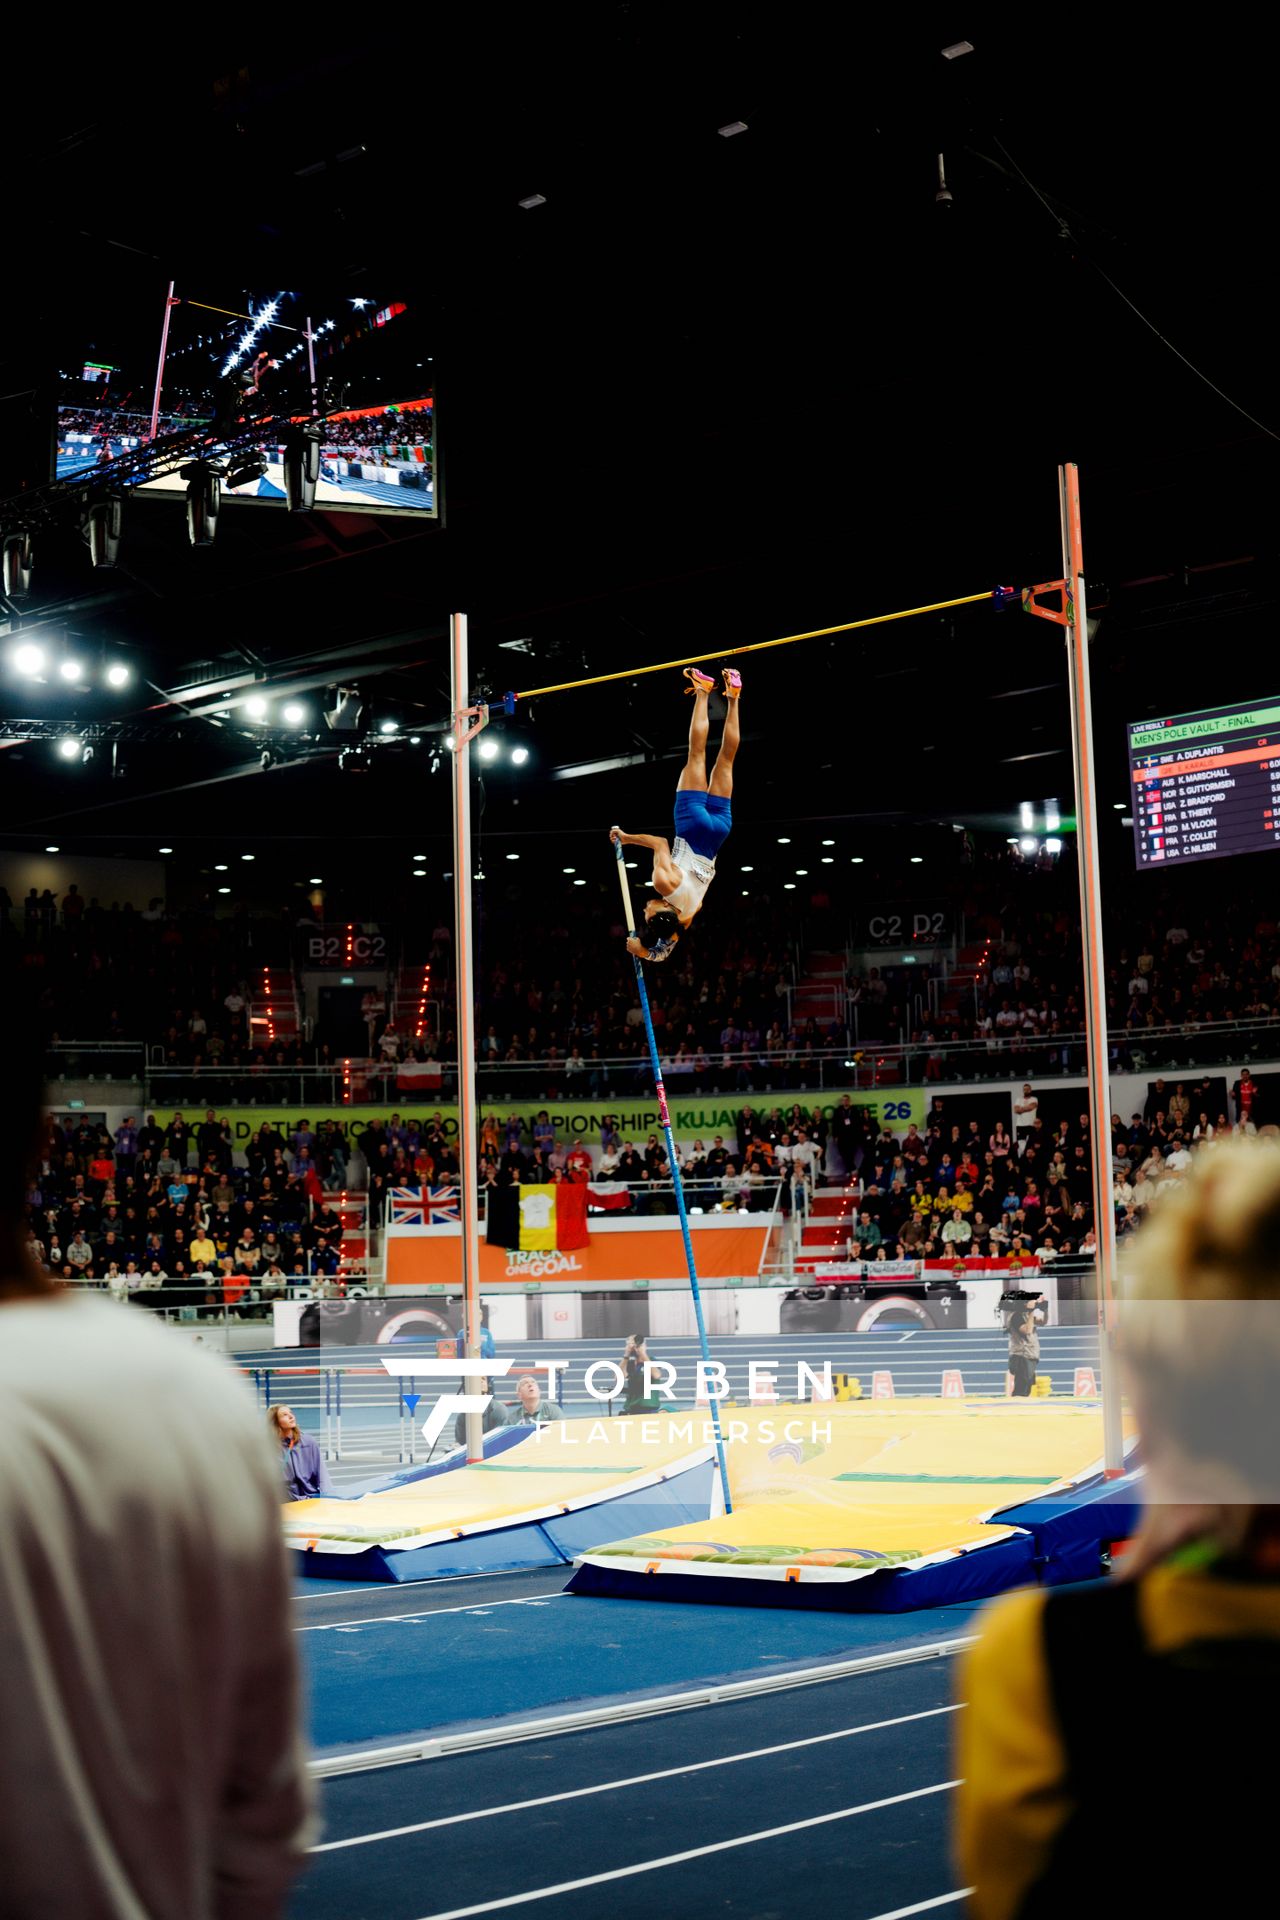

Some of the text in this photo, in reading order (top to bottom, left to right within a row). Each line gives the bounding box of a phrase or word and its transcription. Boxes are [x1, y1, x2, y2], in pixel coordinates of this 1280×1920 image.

[1134, 732, 1163, 745] MEN'S
[1164, 727, 1187, 739] POLE
[1189, 721, 1219, 734] VAULT
[1228, 715, 1255, 727] FINAL
[1184, 745, 1224, 759] DUPLANTIS
[1185, 768, 1230, 783] MARSCHALL
[1162, 789, 1177, 799] NOR
[1186, 779, 1235, 795] GUTTORMSEN
[1163, 802, 1177, 811] USA
[1187, 793, 1226, 807] BRADFORD
[1164, 813, 1177, 822] FRA
[1187, 807, 1213, 818] THIERY
[1165, 825, 1179, 834] NED
[1190, 818, 1217, 830] VLOON
[1165, 837, 1179, 846] FRA
[1189, 830, 1218, 842] COLLET
[1166, 848, 1180, 857] USA
[1190, 842, 1217, 854] NILSEN
[869, 912, 945, 938] C2 D2
[309, 936, 386, 958] B2 C2
[883, 1101, 912, 1120] 26
[529, 1255, 582, 1277] GOAL
[1078, 1380, 1093, 1397] 2
